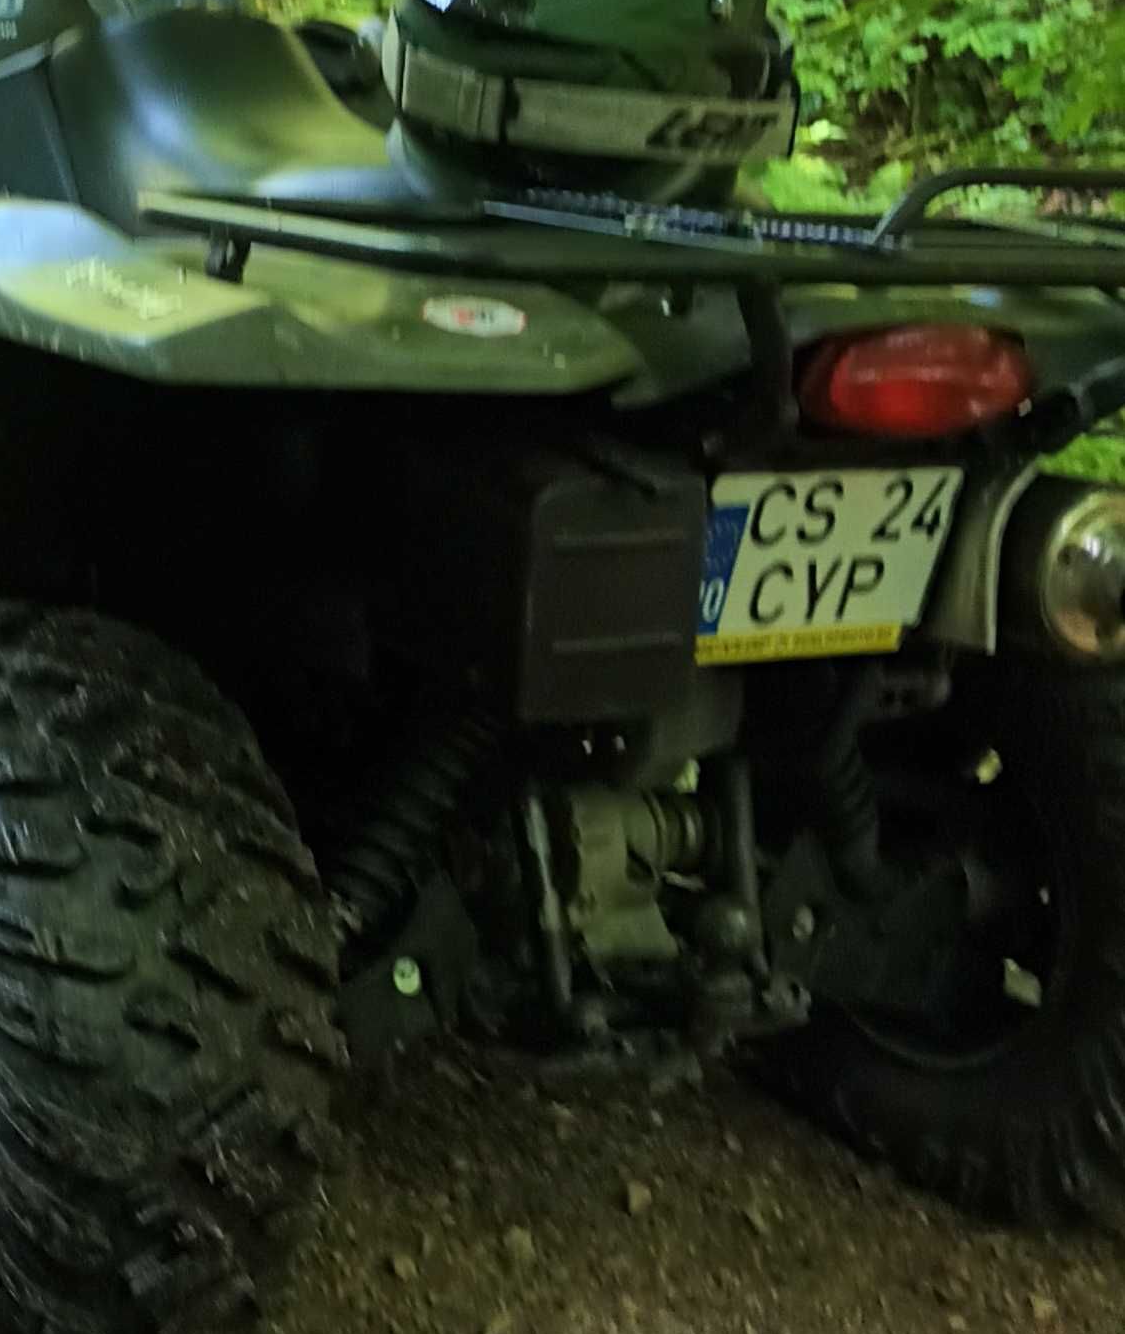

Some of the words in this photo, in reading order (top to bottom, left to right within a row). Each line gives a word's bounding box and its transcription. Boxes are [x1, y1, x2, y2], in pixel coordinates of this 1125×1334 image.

[749, 478, 844, 547] CS
[871, 474, 950, 545] 24
[748, 555, 886, 626] CYP
